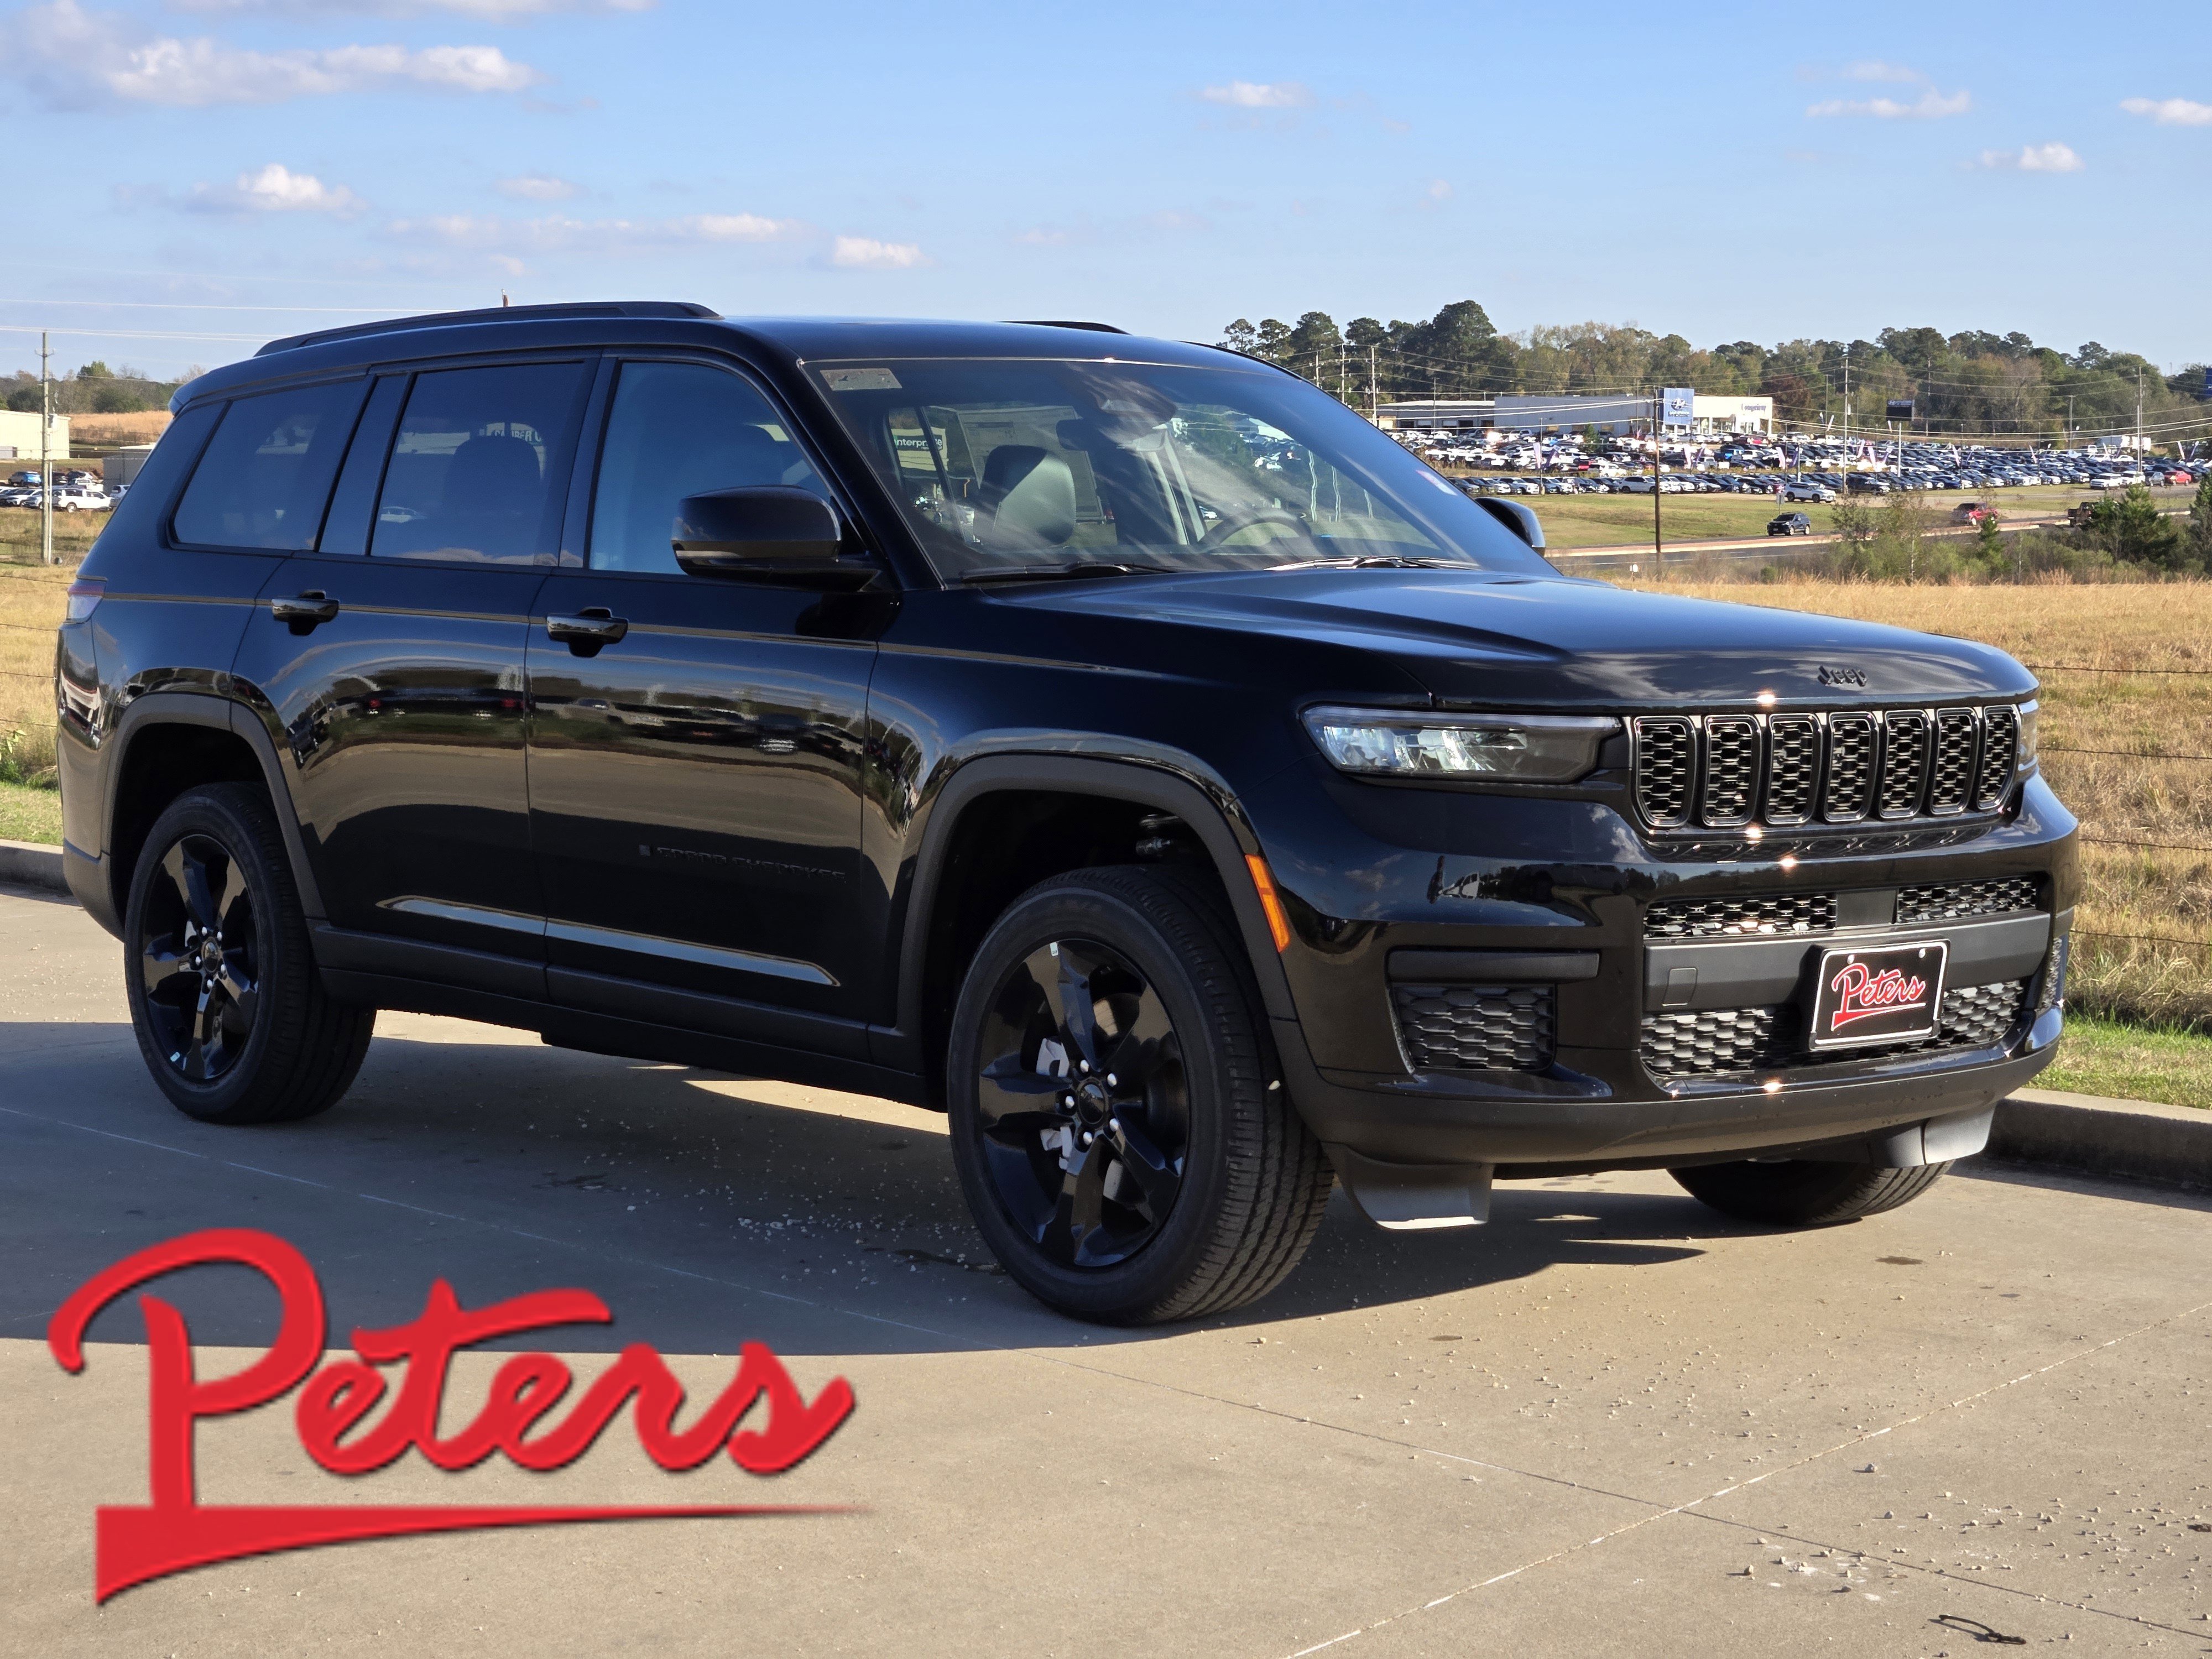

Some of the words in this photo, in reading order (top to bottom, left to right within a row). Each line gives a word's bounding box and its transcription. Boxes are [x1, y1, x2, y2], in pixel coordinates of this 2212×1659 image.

[894, 439, 942, 448] nterpre
[1817, 666, 1867, 687] Jeep
[1832, 962, 1926, 1015] Peters
